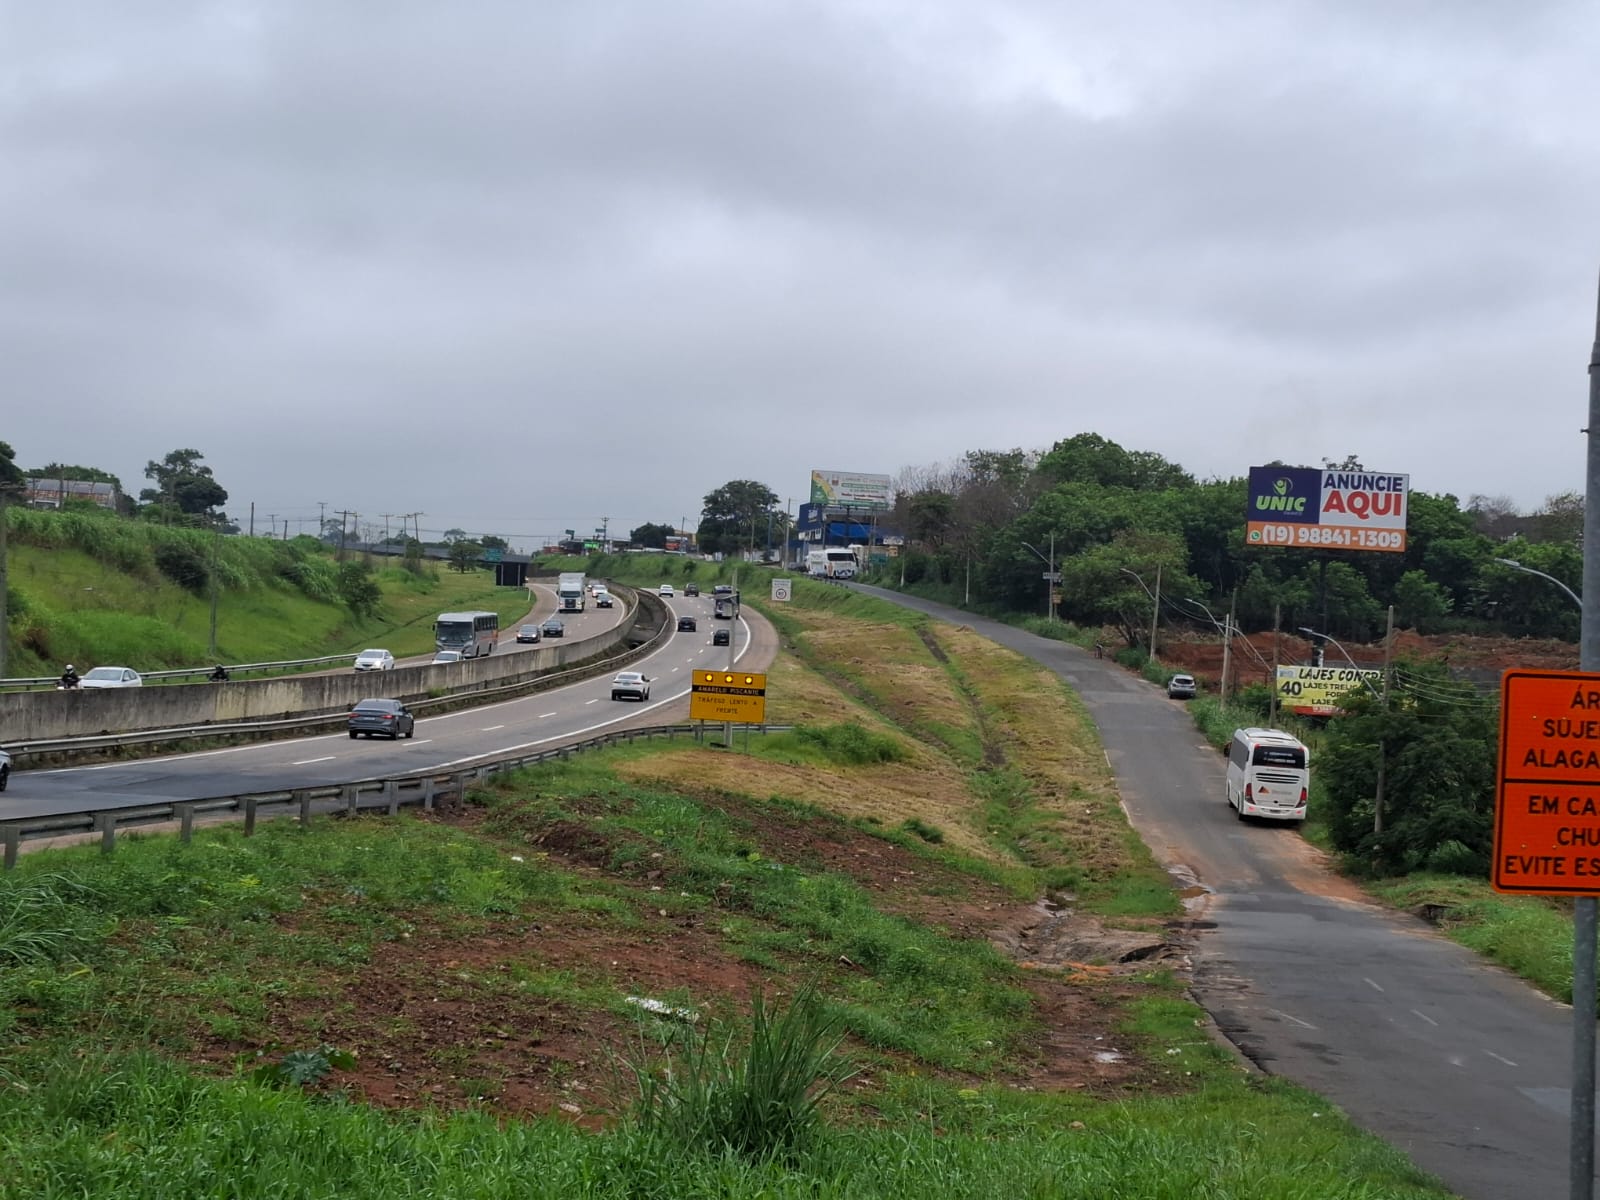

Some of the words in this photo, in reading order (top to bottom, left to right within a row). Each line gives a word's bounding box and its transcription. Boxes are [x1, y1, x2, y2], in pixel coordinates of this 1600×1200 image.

[1323, 473, 1404, 492] ANUNCIE
[1255, 495, 1307, 512] UNIC
[1322, 490, 1403, 520] AQUI
[1262, 524, 1295, 545] (19)
[1298, 527, 1401, 548] 98841-1309
[1299, 668, 1335, 681] LAJES
[1281, 681, 1302, 696] 40
[1528, 795, 1559, 815] EM
[1567, 796, 1600, 816] CA
[1505, 855, 1566, 875] EVITE
